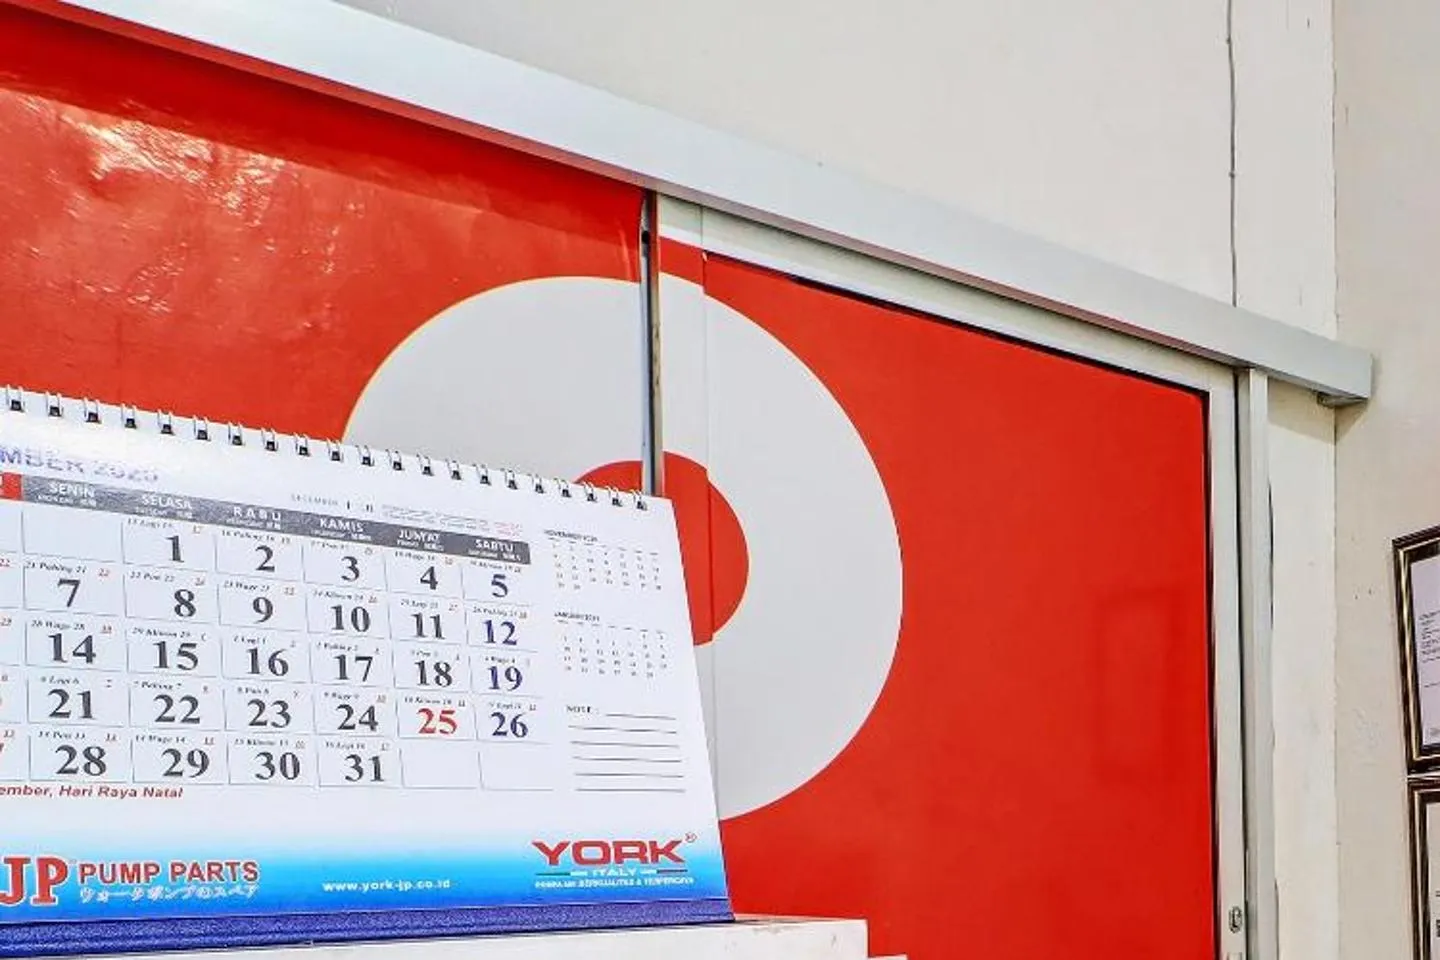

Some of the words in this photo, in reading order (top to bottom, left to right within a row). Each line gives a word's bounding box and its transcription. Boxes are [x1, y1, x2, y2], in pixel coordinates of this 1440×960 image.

[48, 482, 96, 498] SENIN
[319, 518, 365, 533] KAMIS
[166, 535, 184, 563] 1
[255, 545, 276, 572] 2
[341, 556, 360, 582] 3
[420, 566, 439, 590] 4
[491, 574, 508, 598] 5
[57, 578, 81, 608] 7
[174, 589, 196, 617] 8
[252, 597, 273, 624] 9
[330, 605, 371, 632] 10
[411, 612, 446, 640] 11
[483, 619, 518, 646] 12
[48, 633, 96, 664] 14
[152, 640, 199, 671] 15
[246, 647, 289, 677] 16
[334, 654, 374, 682] 17
[414, 660, 453, 687] 18
[487, 665, 523, 691] 19
[48, 688, 95, 720] 21
[153, 694, 201, 724] 22
[247, 699, 292, 728] 23
[336, 704, 379, 732] 24
[416, 708, 458, 734] 25
[490, 711, 529, 738] 26
[54, 744, 107, 776] 28
[161, 748, 210, 778] 29
[255, 752, 300, 780] 30
[344, 754, 385, 782] 31
[59, 785, 93, 797] Hari
[98, 786, 138, 799] Raya
[143, 786, 184, 799] Natal
[79, 862, 160, 885] PUMP
[170, 861, 260, 883] PARTS
[531, 840, 685, 866] YORK
[592, 868, 637, 878] ITALY
